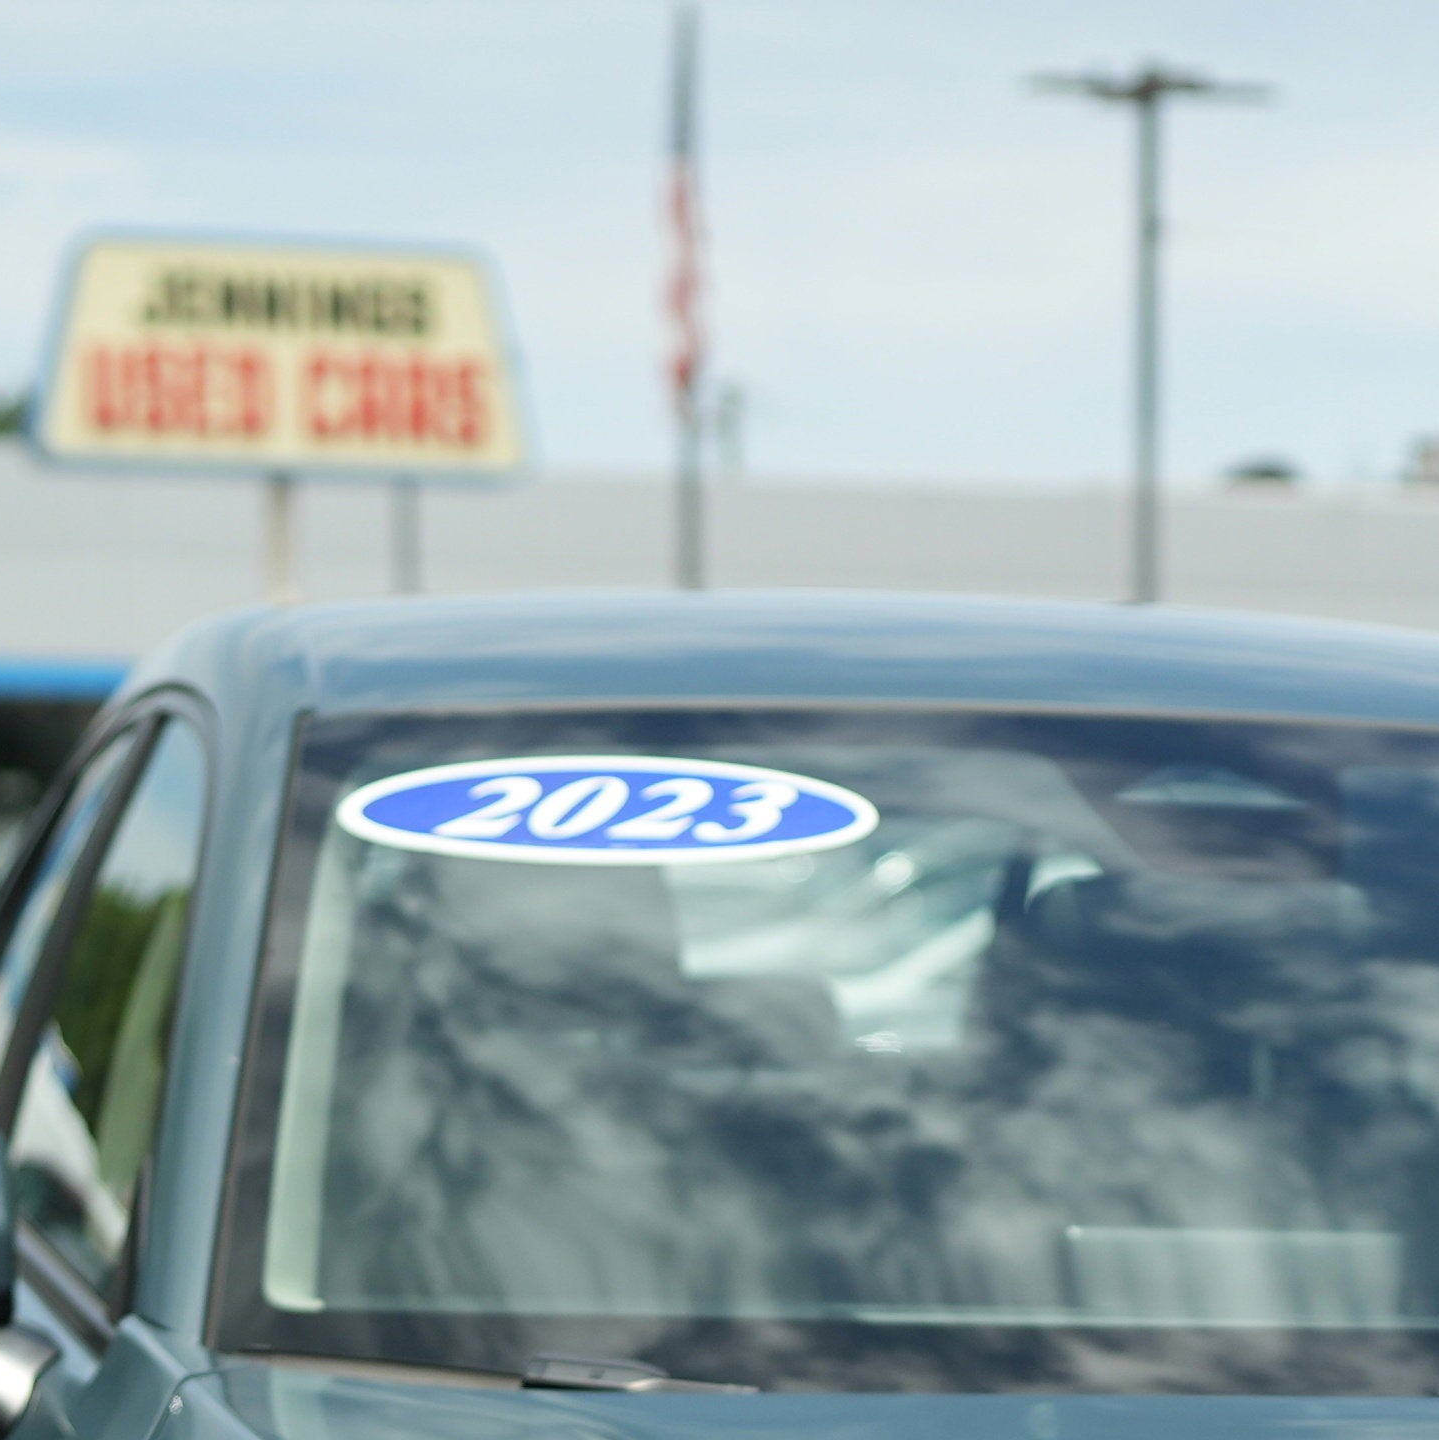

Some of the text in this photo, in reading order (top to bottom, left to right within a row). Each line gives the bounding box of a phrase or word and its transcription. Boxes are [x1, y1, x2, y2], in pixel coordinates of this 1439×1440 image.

[137, 268, 431, 335] JENNINGS
[89, 344, 486, 446] USED CARS
[432, 775, 800, 843] 2023
